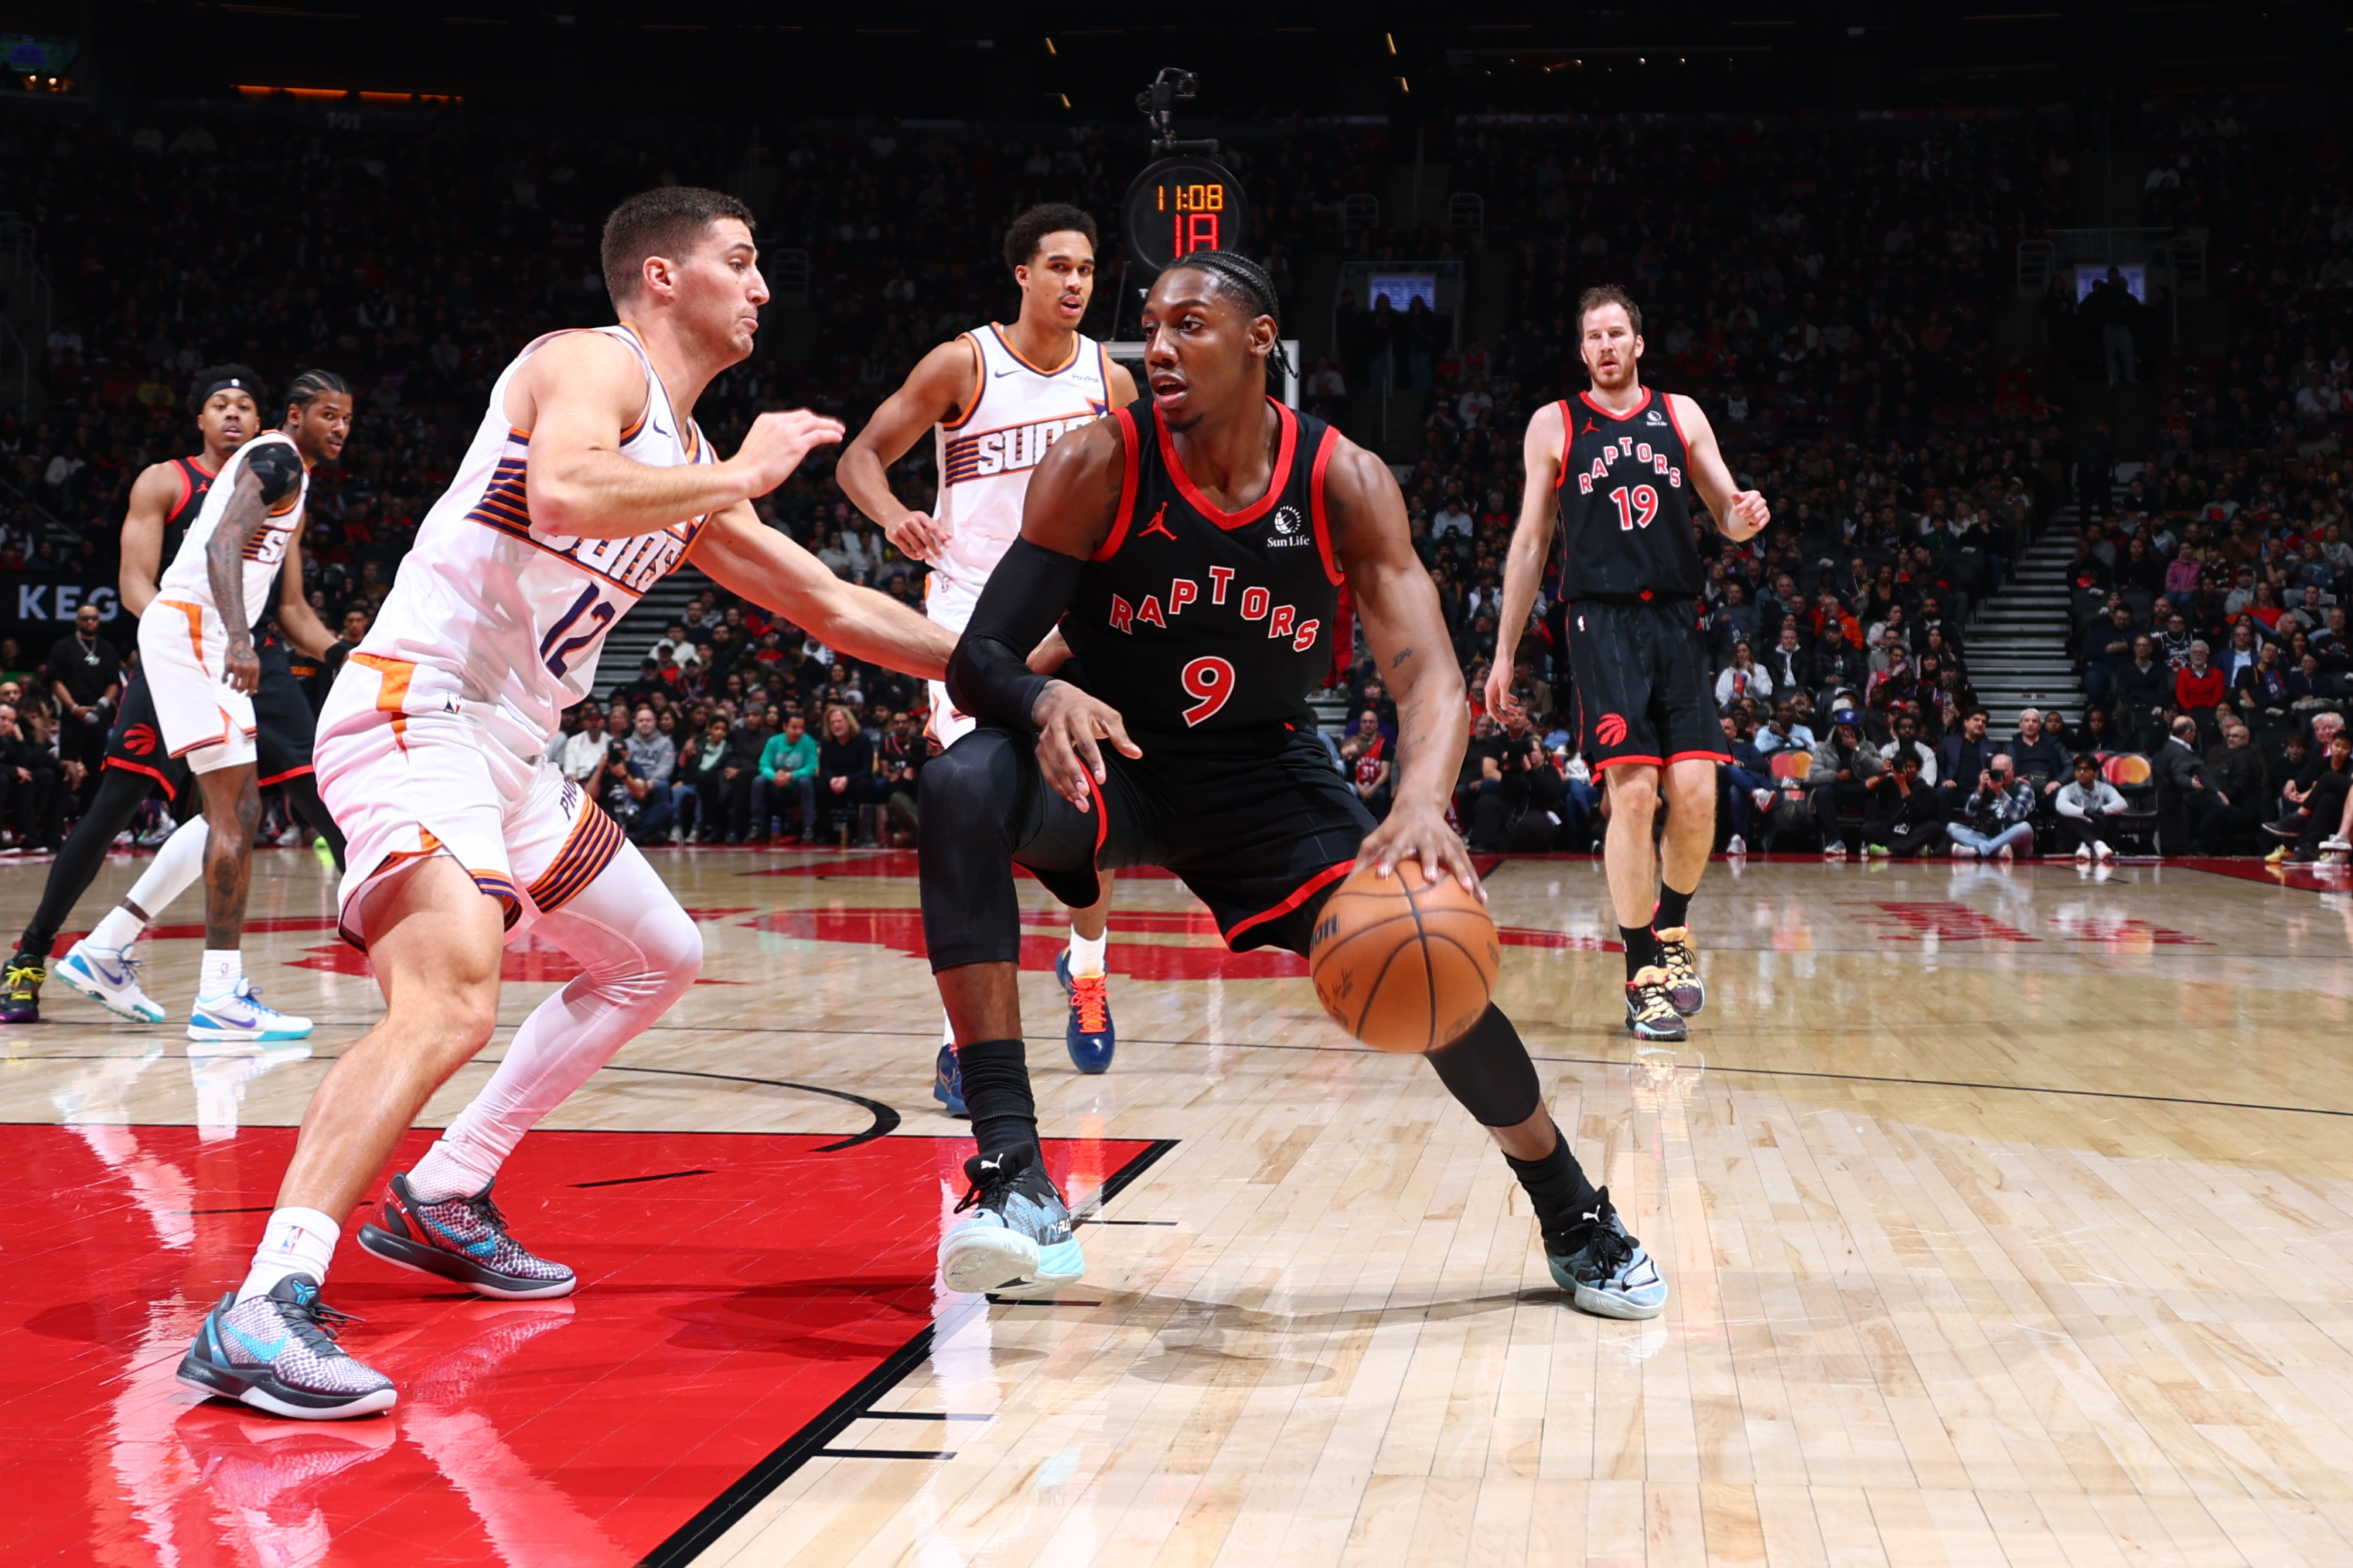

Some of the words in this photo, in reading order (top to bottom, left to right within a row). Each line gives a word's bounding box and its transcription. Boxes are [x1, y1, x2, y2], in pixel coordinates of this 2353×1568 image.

[1157, 184, 1223, 211] 11:08
[1072, 373, 1100, 383] PayPal
[977, 418, 1089, 476] SUN
[1578, 437, 1681, 494] RAPTORS
[1609, 484, 1659, 531] 19
[1267, 536, 1287, 548] Sun
[1289, 535, 1311, 547] Life
[17, 585, 121, 621] KEG
[1109, 565, 1320, 653] RAPTORS
[539, 581, 616, 680] 12
[1181, 655, 1236, 728] 9
